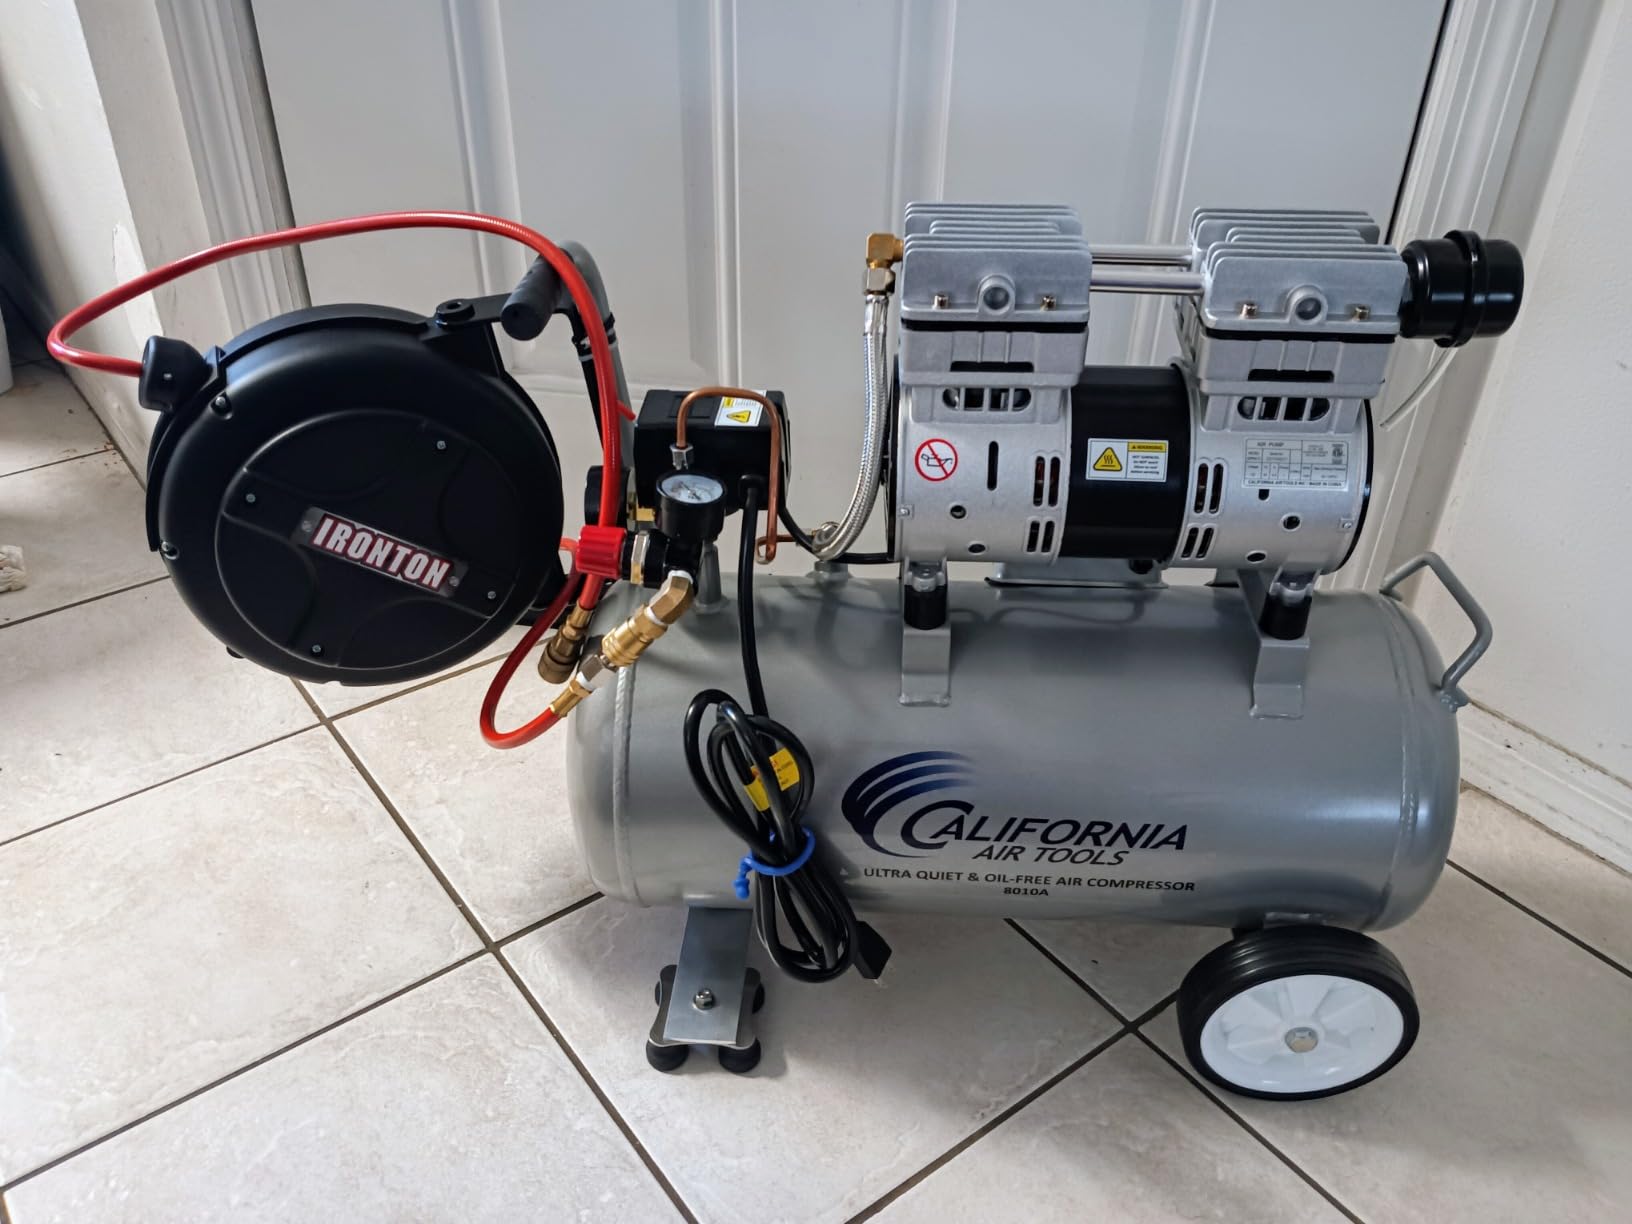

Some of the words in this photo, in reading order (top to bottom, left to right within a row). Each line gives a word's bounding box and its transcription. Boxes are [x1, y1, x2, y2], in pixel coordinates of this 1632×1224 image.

[312, 516, 451, 590] IRONTON
[900, 799, 1188, 851] CALIFORNIA
[971, 844, 1021, 863] AIR
[1034, 846, 1130, 867] TOOLS
[863, 867, 912, 879] ULTRA
[915, 870, 964, 882] QUIET
[967, 872, 978, 883] &
[984, 873, 1052, 886] OIL-FREE
[1055, 876, 1083, 888] AIR
[1086, 877, 1196, 892] COMPRESSOR
[1003, 886, 1050, 897] 8010A
